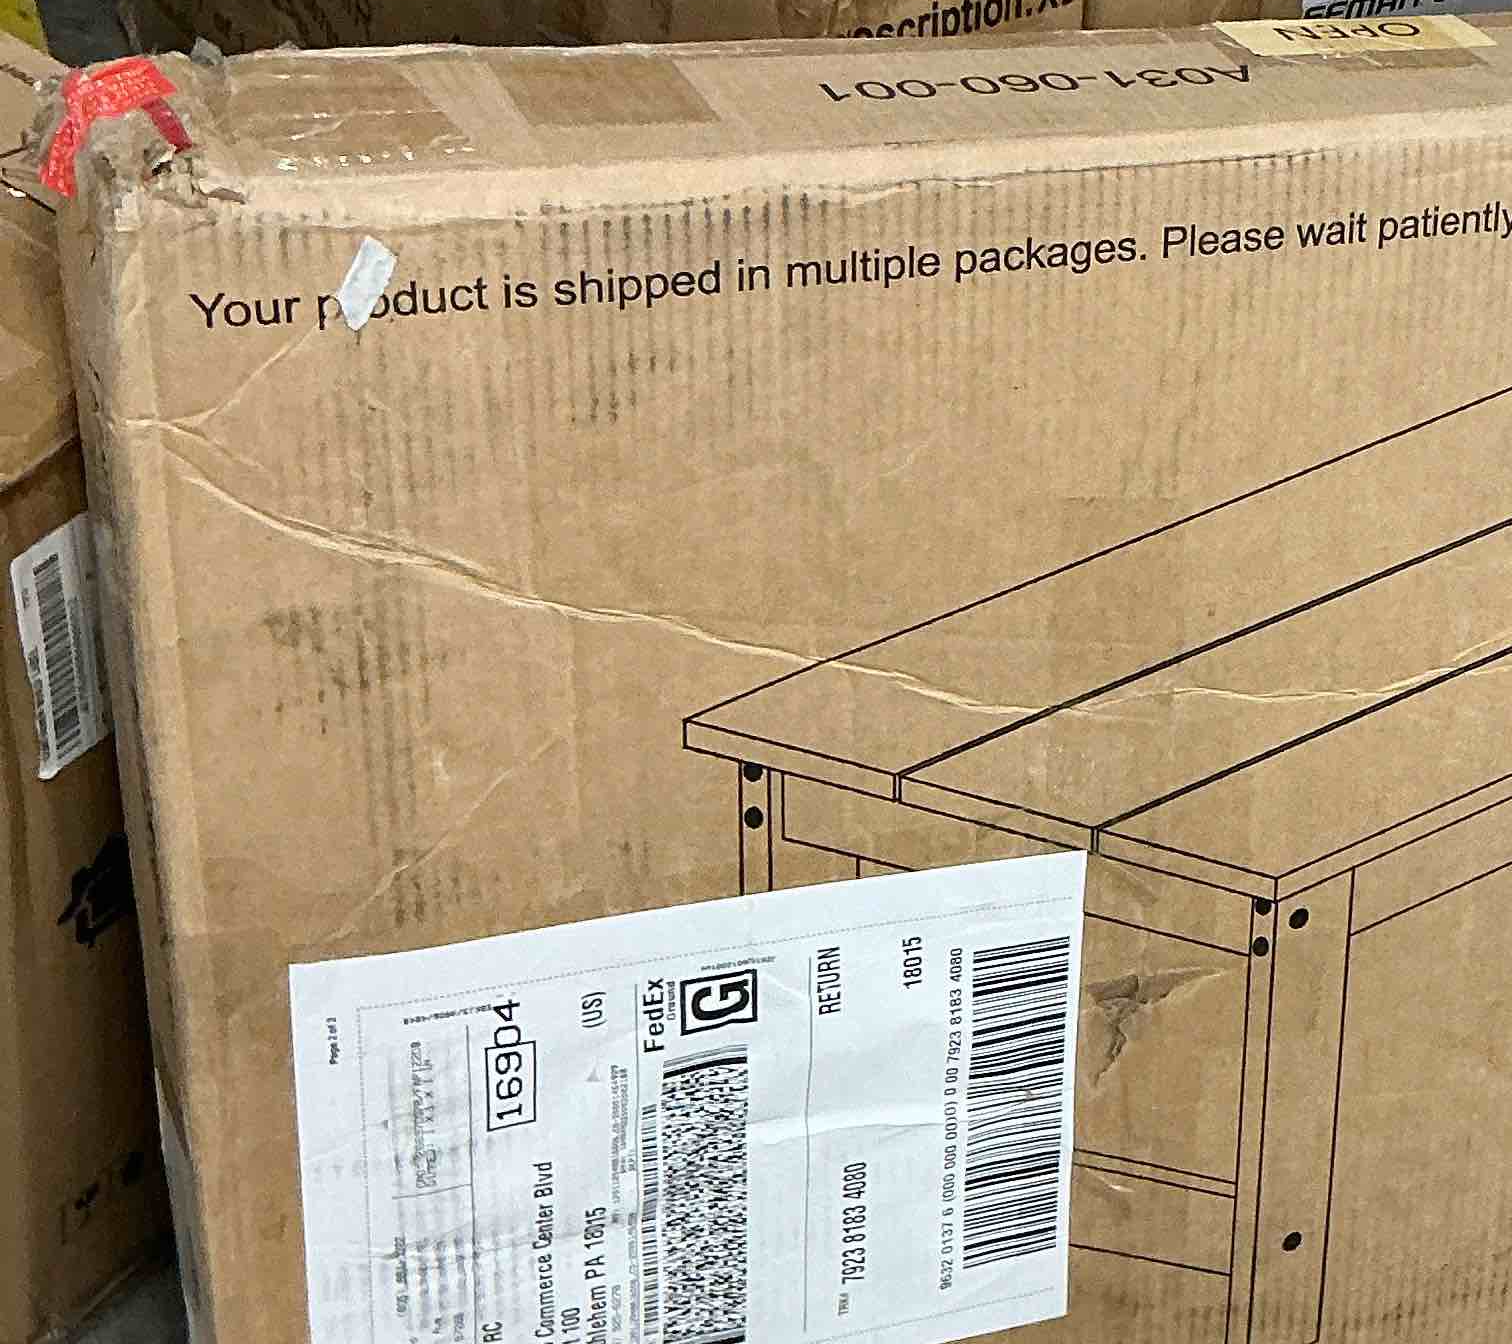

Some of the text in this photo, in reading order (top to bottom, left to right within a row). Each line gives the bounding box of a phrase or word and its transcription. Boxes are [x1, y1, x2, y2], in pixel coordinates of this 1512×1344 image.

[1274, 21, 1421, 43] OPEN
[817, 64, 1251, 102] A031-060-001
[189, 292, 302, 330] Your
[317, 276, 490, 331] poduct
[502, 273, 539, 310] is
[553, 259, 723, 312] shipped
[736, 257, 773, 292] in
[785, 244, 942, 289] multiple
[955, 228, 1148, 282] packages.
[1161, 221, 1286, 259] Please
[1295, 211, 1368, 248] wait
[818, 945, 842, 1016] RETURN
[902, 935, 923, 990] 18015
[947, 947, 963, 982] 4080
[580, 991, 607, 1028] (US)
[643, 976, 665, 1053] FedEx
[690, 977, 751, 1023] G
[945, 988, 962, 1025] 8183
[945, 1029, 961, 1062] 7923
[533, 1161, 553, 1201] Blvd
[843, 1161, 868, 1201] 4080
[532, 1205, 554, 1250] Center
[843, 1205, 867, 1244] 8183
[584, 1253, 607, 1280] PA
[841, 1247, 866, 1286] 7923
[534, 1253, 555, 1338] Commerce
[482, 1320, 503, 1342] RC
[558, 1306, 581, 1334] 100
